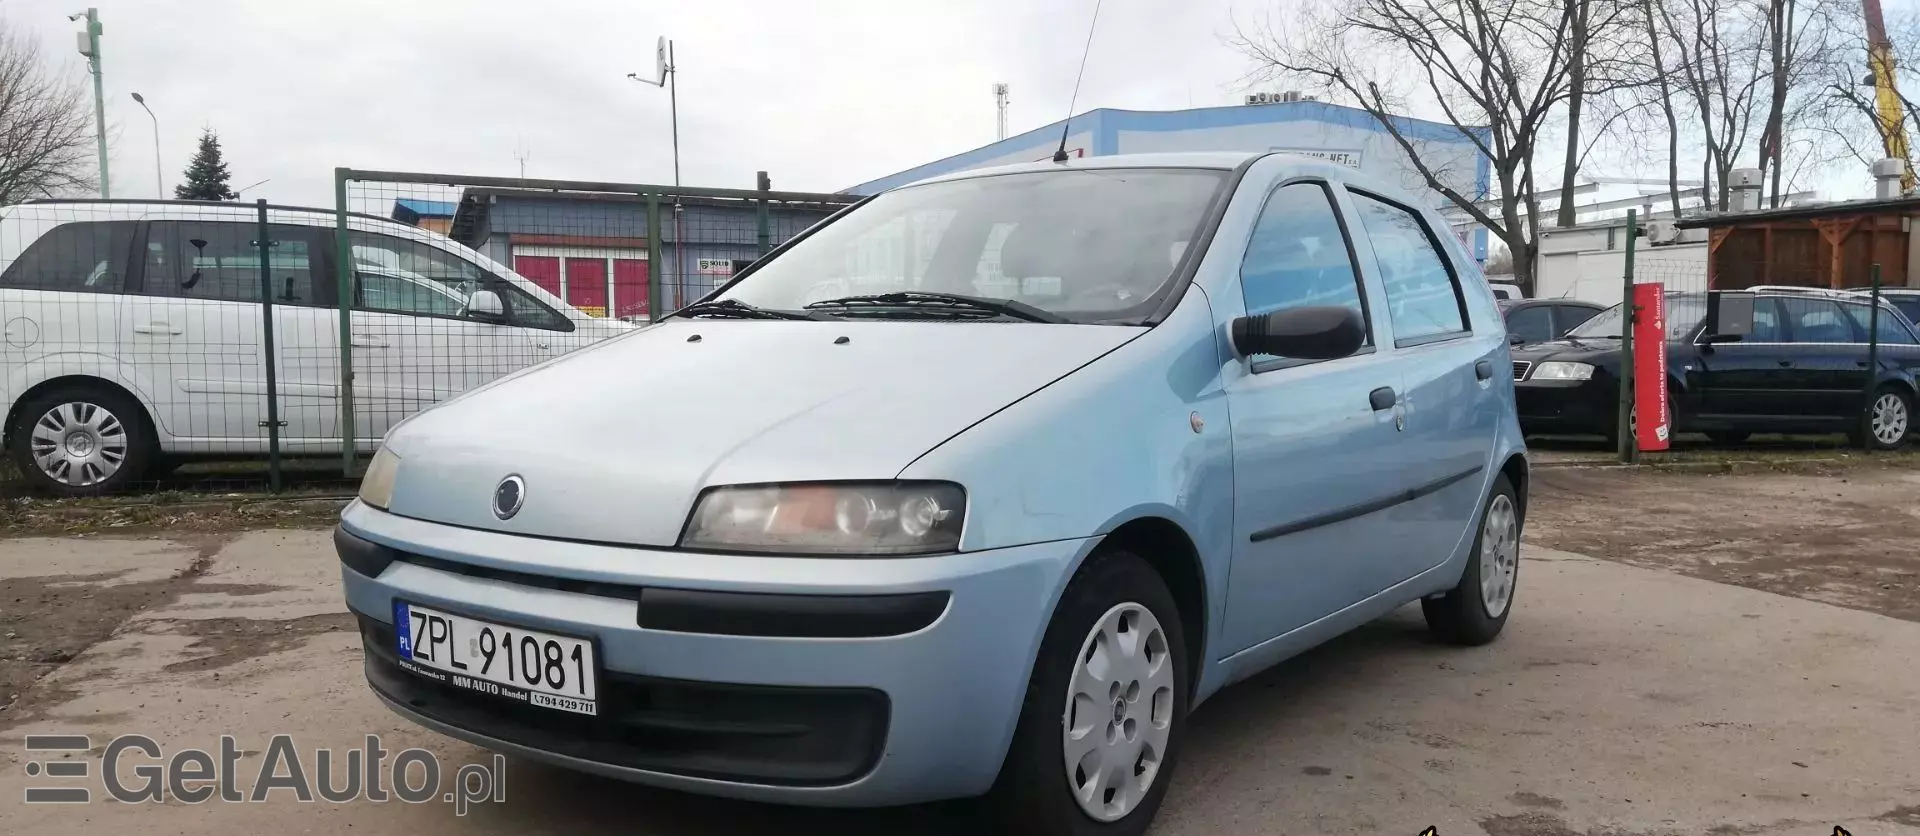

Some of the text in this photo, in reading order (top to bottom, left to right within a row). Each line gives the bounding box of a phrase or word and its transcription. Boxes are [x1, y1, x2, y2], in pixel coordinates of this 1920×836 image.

[400, 636, 410, 651] PL
[410, 610, 585, 695] ZPL 91081
[452, 675, 593, 713] MM AUTO Handel 794 429 711
